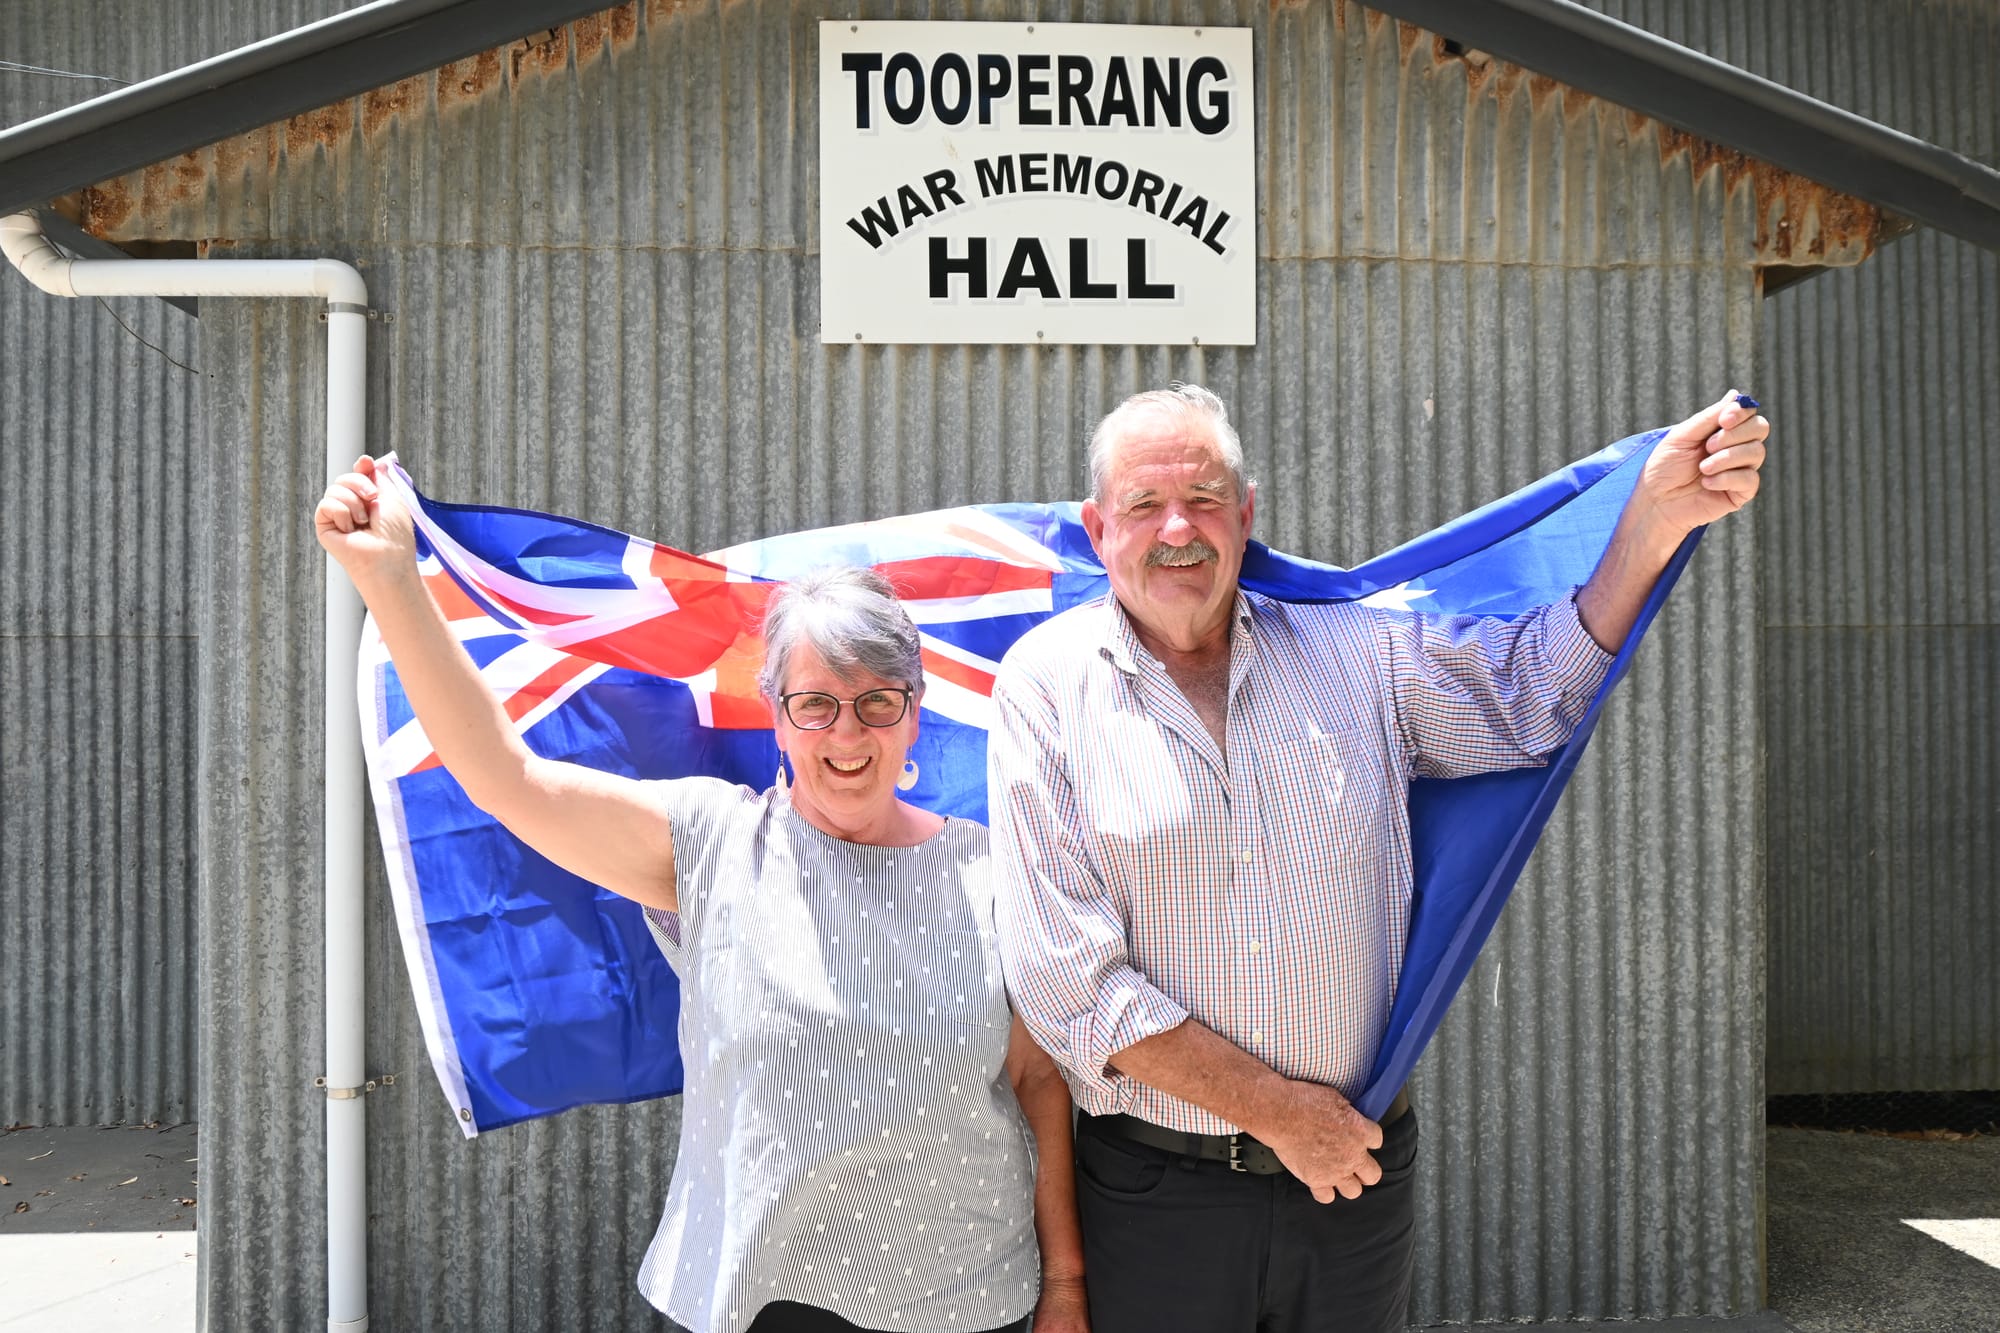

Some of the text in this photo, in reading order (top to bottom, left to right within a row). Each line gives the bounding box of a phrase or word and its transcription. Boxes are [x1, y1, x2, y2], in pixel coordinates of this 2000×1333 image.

[841, 52, 1230, 135] TOOPERANG
[846, 152, 1231, 256] WAR MEMORIAL
[928, 236, 1175, 299] HALL
